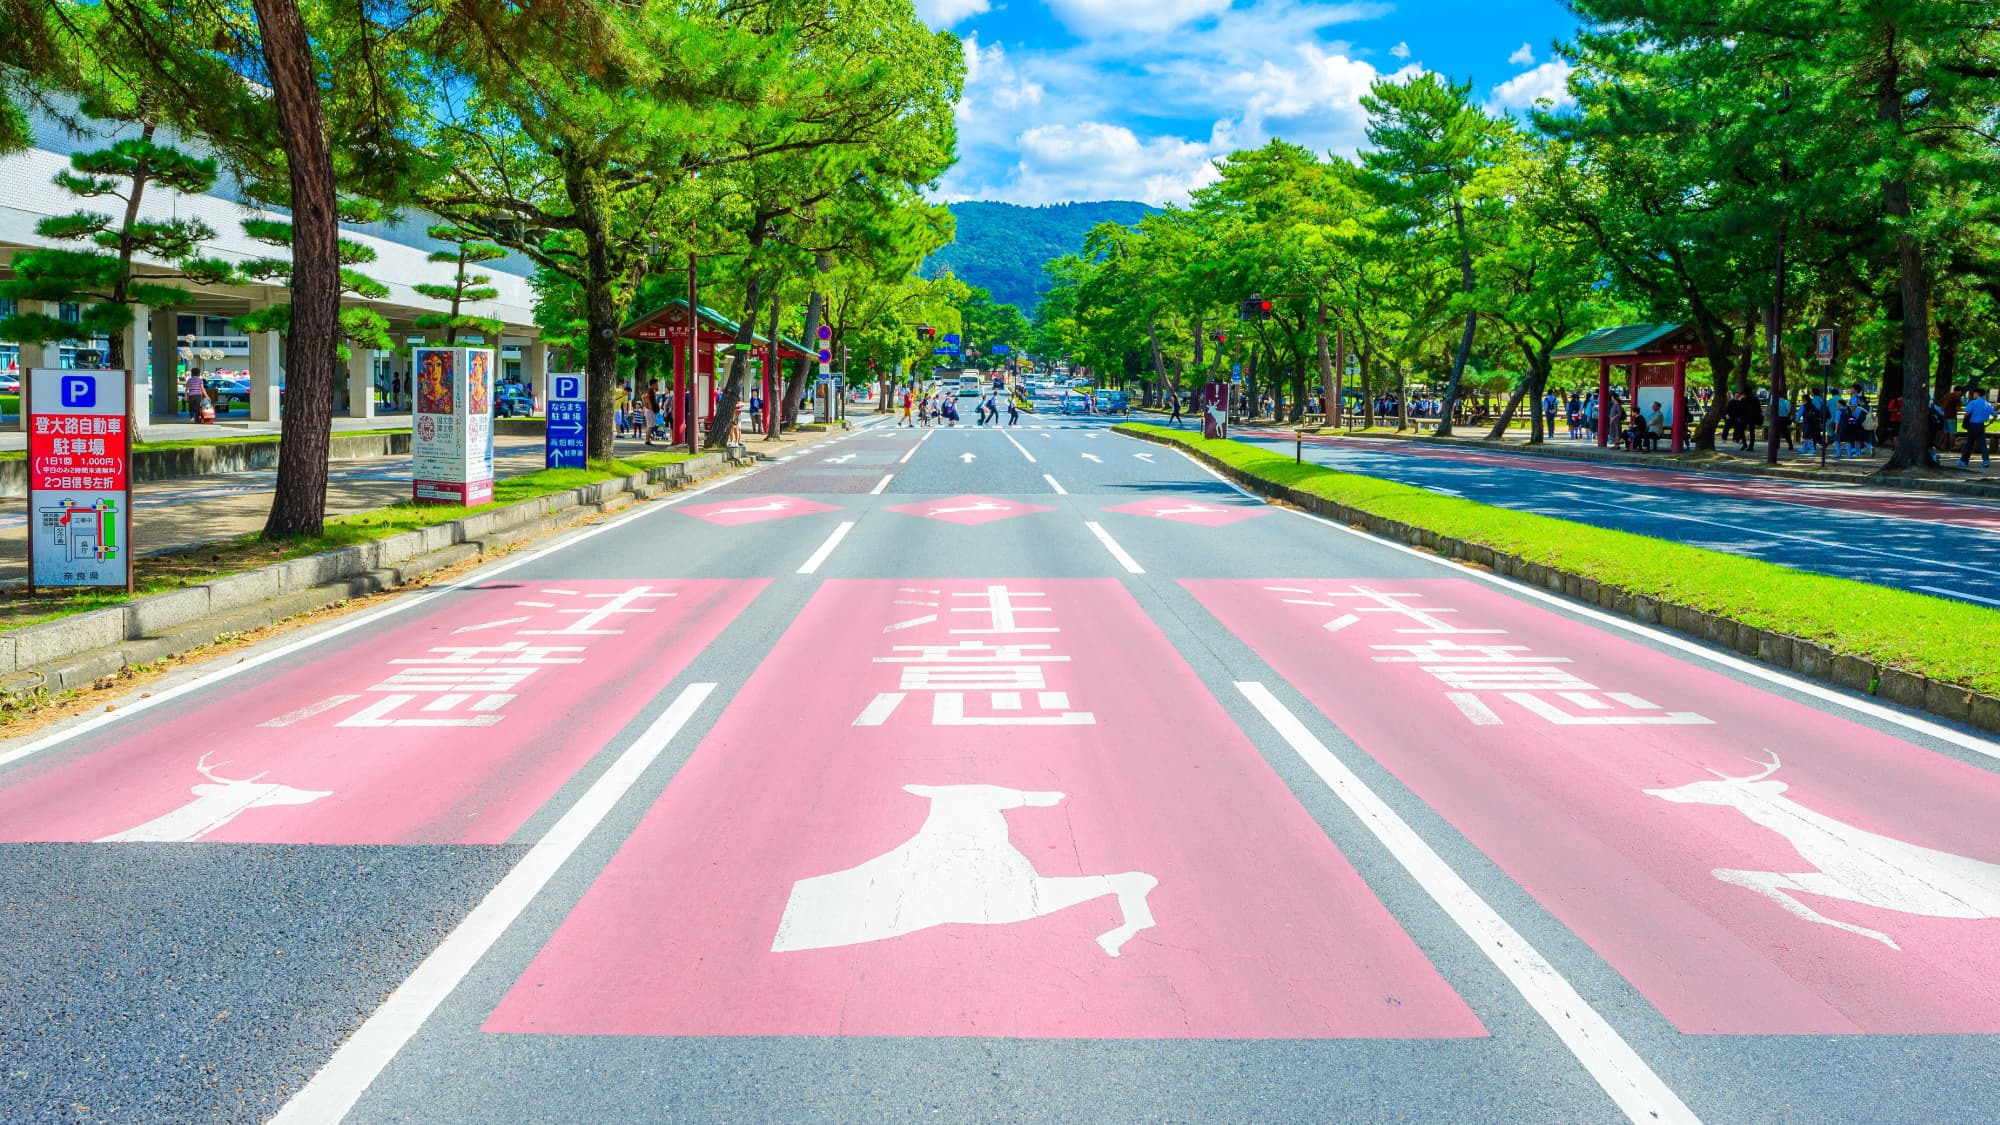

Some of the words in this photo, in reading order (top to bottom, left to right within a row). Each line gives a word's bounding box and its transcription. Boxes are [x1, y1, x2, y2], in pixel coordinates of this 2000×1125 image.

[70, 380, 88, 403] P
[560, 379, 574, 397] P
[551, 403, 582, 412] ならまち
[551, 412, 581, 421] 駐車場
[35, 416, 122, 435] 登大路自動車
[53, 437, 105, 456] 駐車場
[44, 476, 114, 489] 2つ目信号左折
[63, 571, 99, 581] 奈良県
[256, 586, 678, 727] 注意
[851, 585, 1096, 726] 注意
[1264, 585, 1717, 725] 注意
